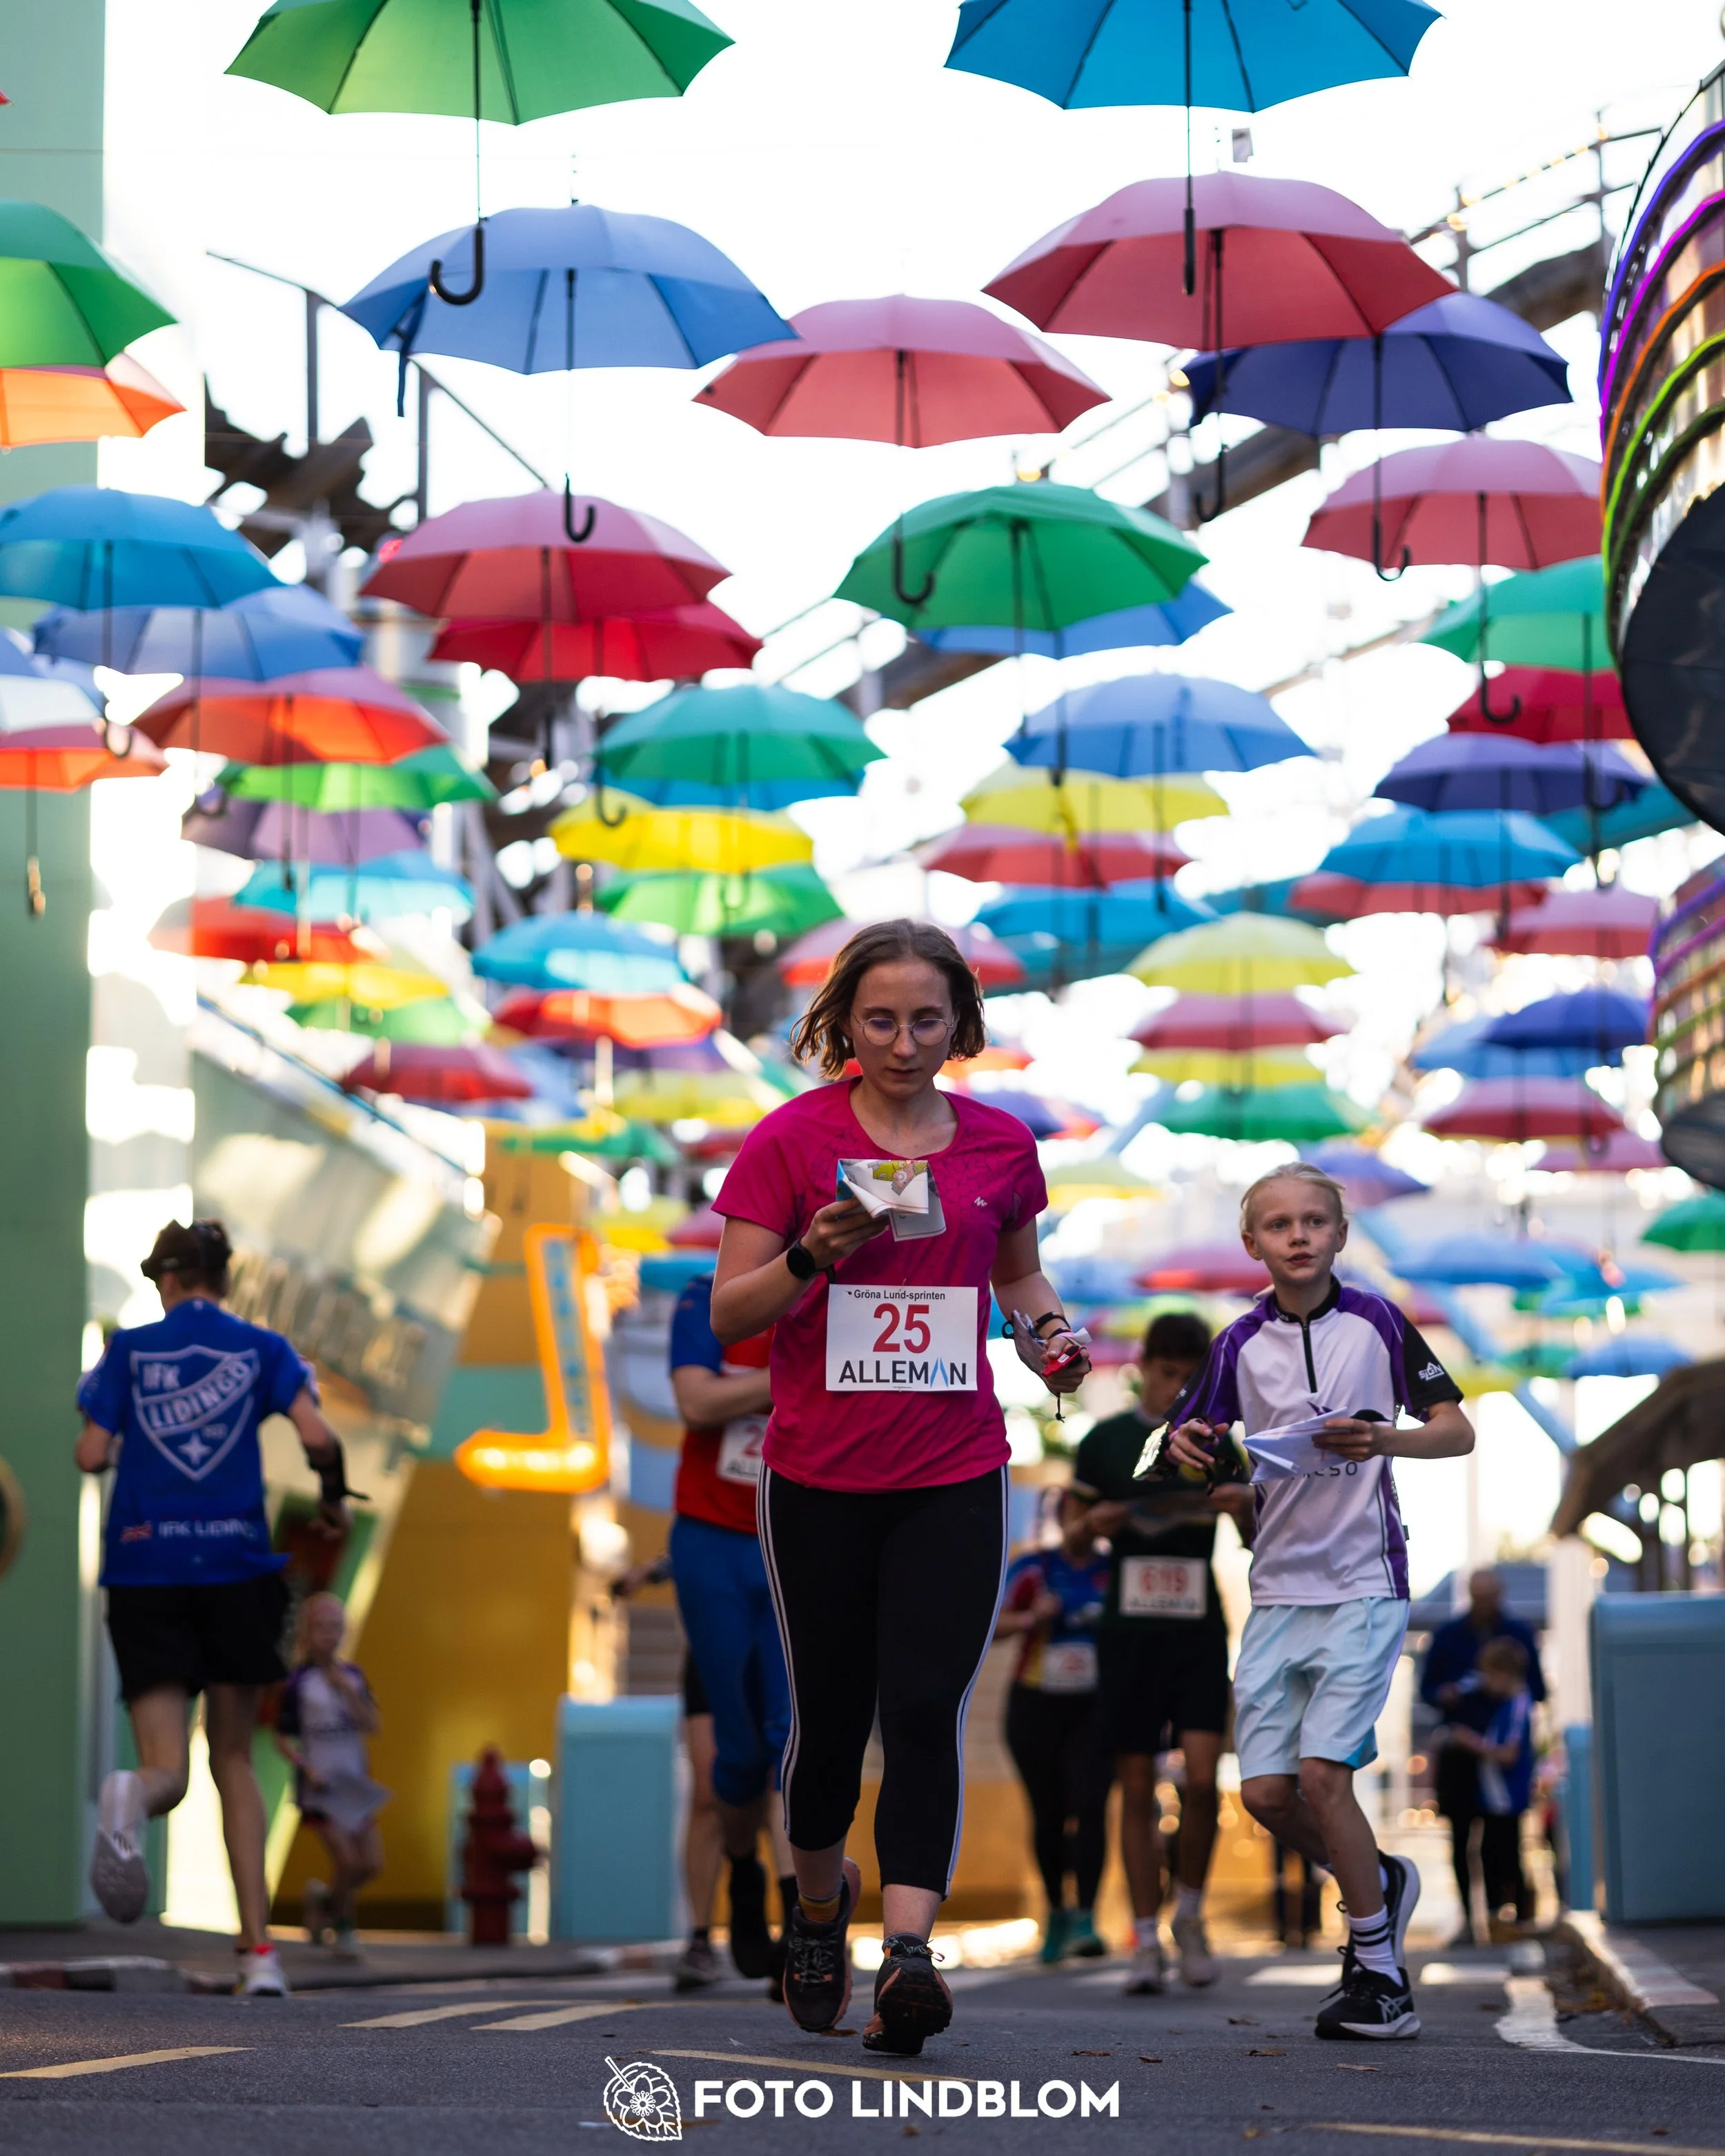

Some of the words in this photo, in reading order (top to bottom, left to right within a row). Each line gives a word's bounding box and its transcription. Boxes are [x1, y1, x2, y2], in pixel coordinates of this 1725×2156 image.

[854, 1289, 881, 1299] Gröna
[883, 1289, 945, 1301] Lund-sprinten
[872, 1303, 931, 1354] 25
[838, 1357, 967, 1388] ALLEMAN
